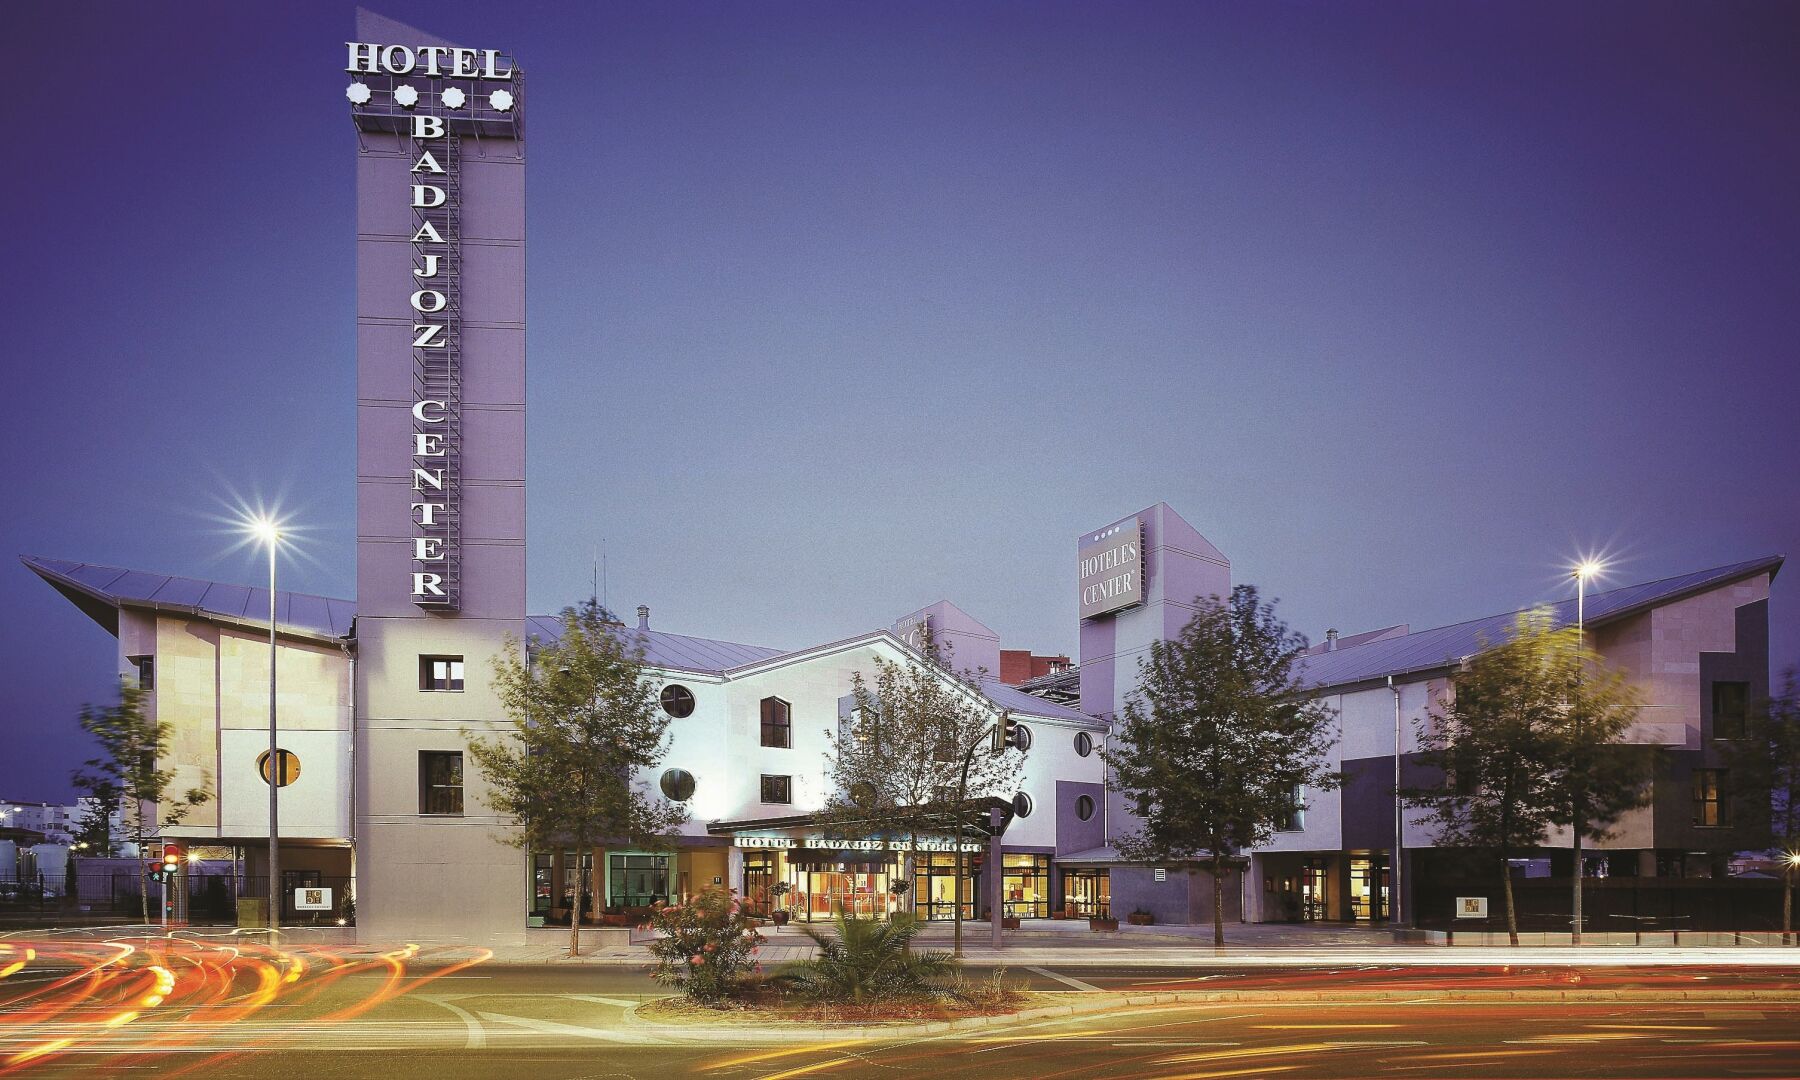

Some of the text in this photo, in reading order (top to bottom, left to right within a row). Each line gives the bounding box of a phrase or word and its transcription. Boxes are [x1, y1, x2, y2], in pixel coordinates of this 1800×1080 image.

[345, 42, 513, 79] HOTEL
[410, 115, 448, 596] BADAJOZ CENTER
[1080, 541, 1136, 580] HOTELES
[1083, 572, 1132, 606] CENTER
[739, 838, 797, 848] HOTEL
